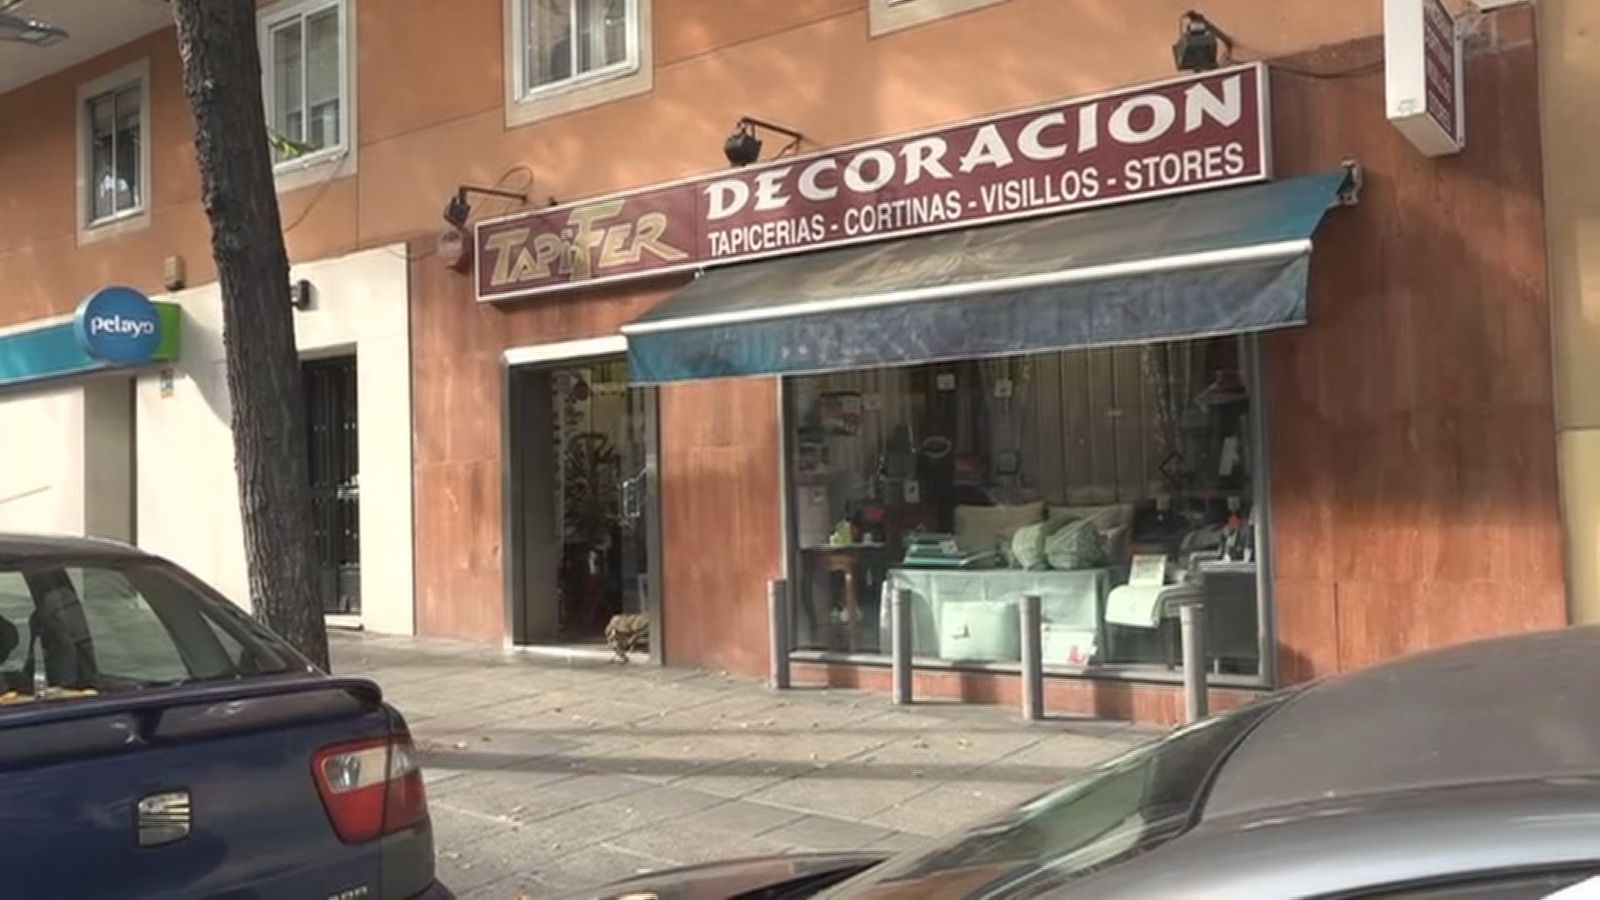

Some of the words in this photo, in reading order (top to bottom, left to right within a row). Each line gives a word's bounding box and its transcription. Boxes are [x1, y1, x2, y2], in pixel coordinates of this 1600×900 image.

[703, 74, 1241, 220] DECORACION
[708, 214, 825, 257] TAPICERIAS
[844, 193, 962, 236] CORTINAS
[981, 166, 1099, 213] VISILLOS
[1124, 142, 1244, 191] STORES
[90, 314, 154, 339] pelayo
